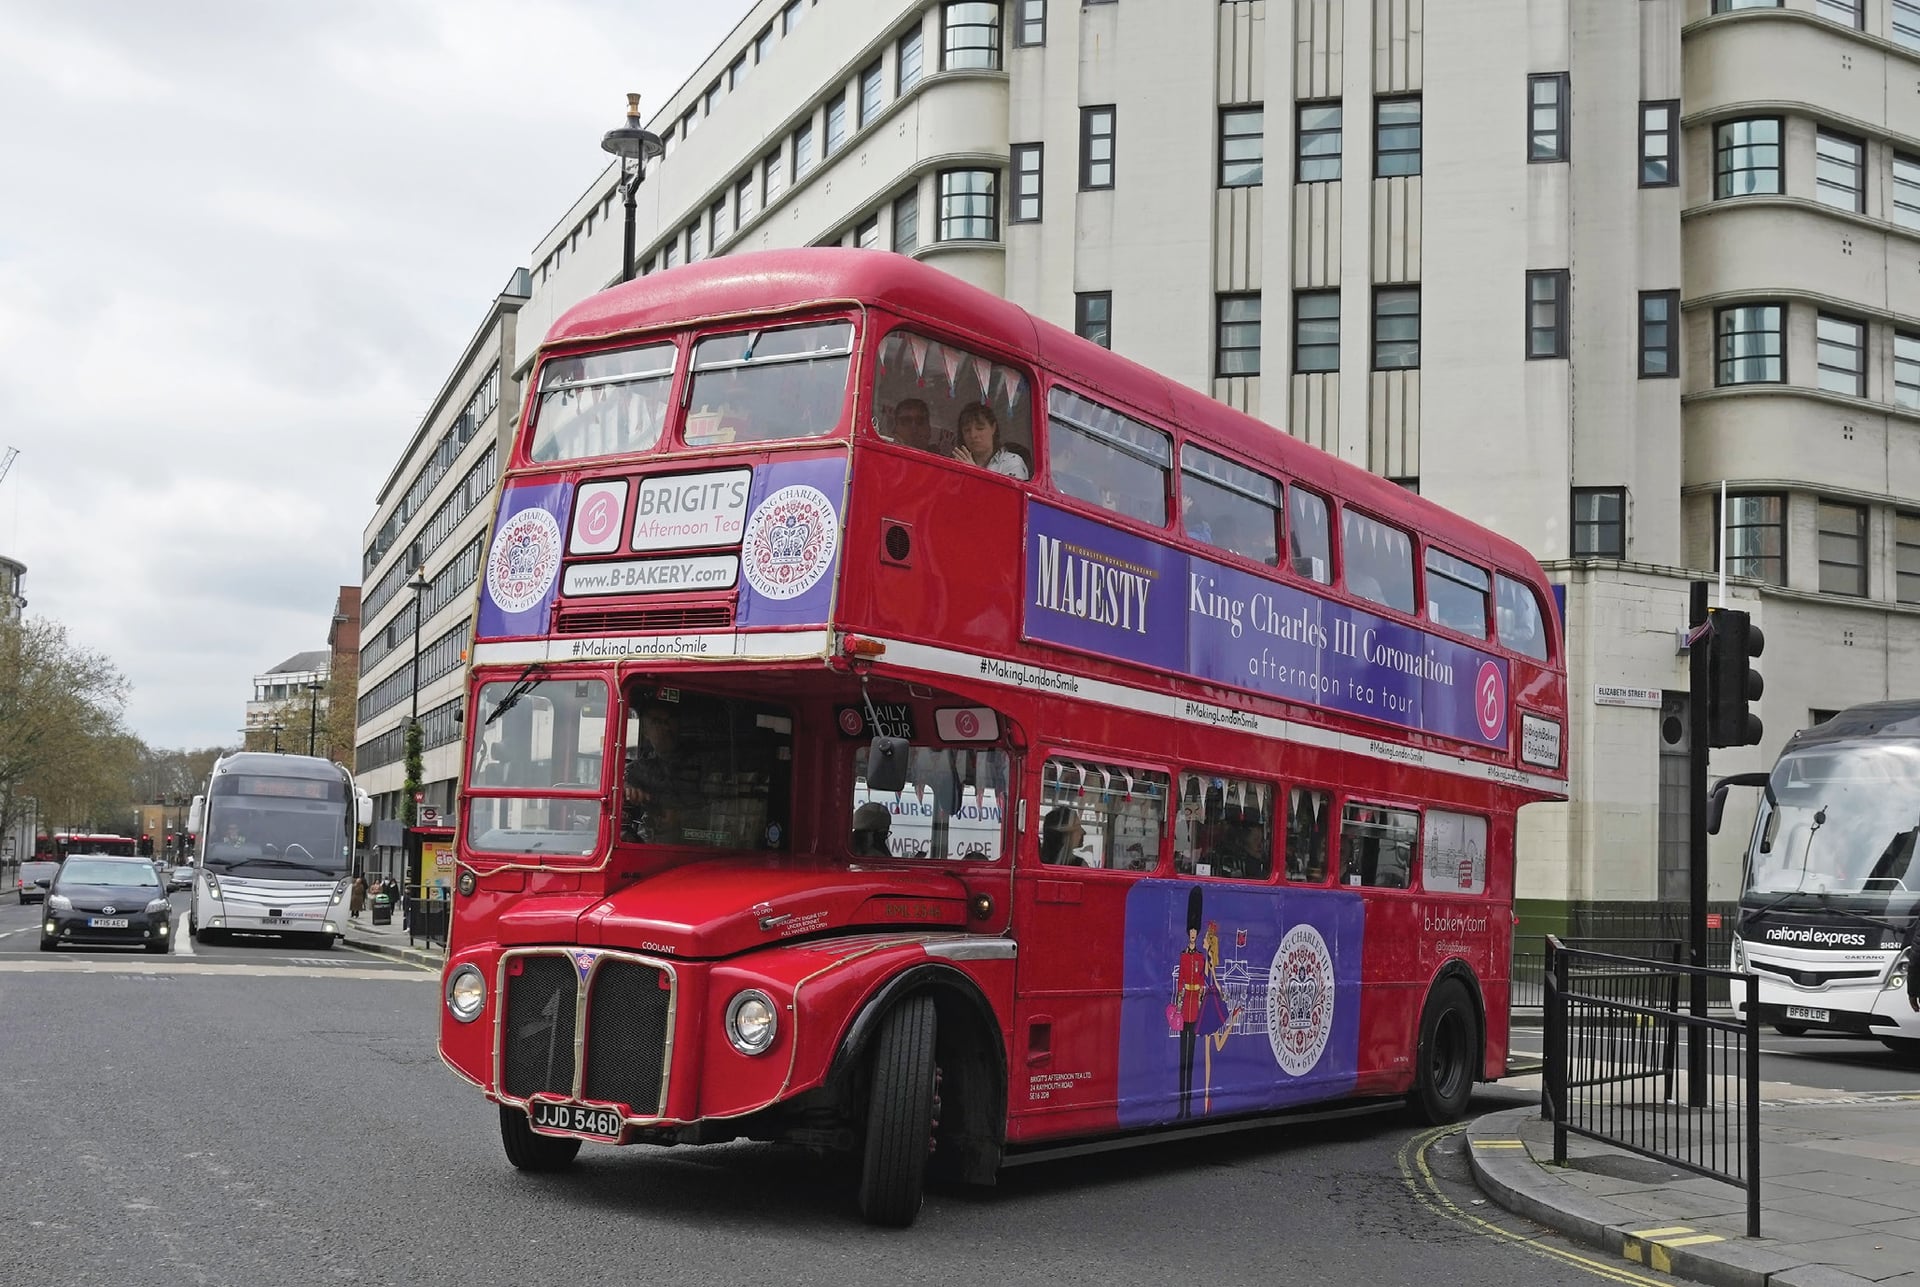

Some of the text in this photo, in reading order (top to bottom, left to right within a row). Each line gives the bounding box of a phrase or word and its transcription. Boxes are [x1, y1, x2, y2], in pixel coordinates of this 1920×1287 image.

[640, 481, 745, 516] BRIGIT'S
[755, 489, 831, 523] KING CHARLES III
[499, 519, 518, 542] KING
[519, 511, 552, 530] CHARLES
[637, 515, 741, 538] Afternoon Tea
[574, 564, 727, 588] www.B-BAKERY.com
[744, 528, 835, 595] CORONATION 6TH MAY 2023
[1105, 556, 1123, 567] ROYAL
[489, 552, 513, 609] CORONATION
[521, 595, 538, 608] 6TH
[537, 576, 551, 596] MAY
[1035, 533, 1151, 634] MAJESTY
[1188, 571, 1454, 686] King Charles III Coronation
[980, 658, 1079, 693] #MakingLondonSmile
[1248, 647, 1413, 713] afternoon tea tour
[1598, 687, 1659, 699] ELIZABETH STREET SW1
[864, 705, 906, 721] DAILY
[1185, 702, 1258, 729] #MakingLondonSmile
[868, 722, 912, 738] TOUR
[1424, 905, 1486, 939] b-bakery.com
[1766, 926, 1866, 947] national express
[641, 941, 675, 954] COOLANT
[1291, 930, 1323, 955] CHARLES
[1321, 953, 1329, 972] III
[1268, 986, 1297, 1069] CORONATION
[1302, 1050, 1317, 1069] 6TH
[1316, 1026, 1329, 1051] MAY
[1048, 1073, 1074, 1081] AFTERNOON
[1061, 1081, 1074, 1089] ROAD
[536, 1105, 619, 1135] JJD 546D
